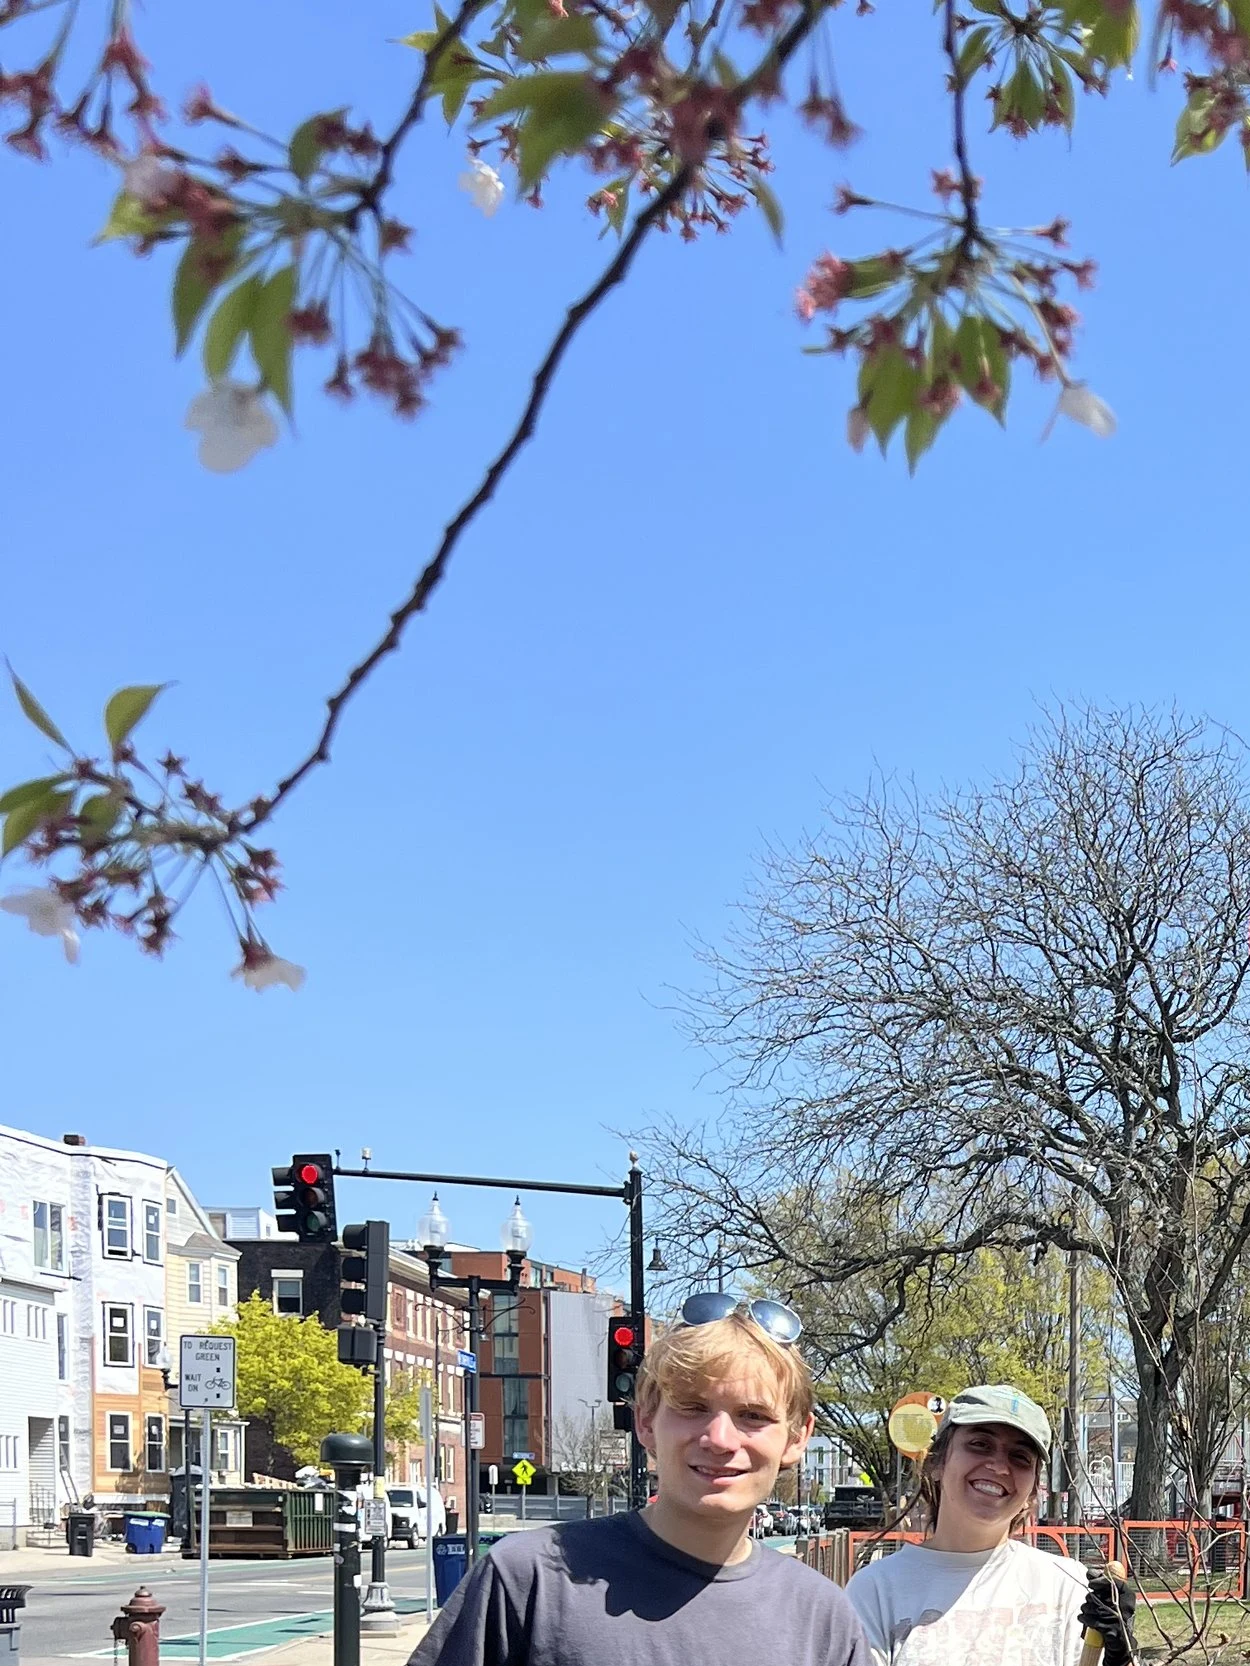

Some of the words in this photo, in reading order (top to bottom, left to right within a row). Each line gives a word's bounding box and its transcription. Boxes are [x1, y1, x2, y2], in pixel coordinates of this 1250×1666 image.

[183, 1341, 193, 1349] TO
[199, 1342, 232, 1350] REQUEST
[195, 1352, 220, 1361] GREEN
[184, 1374, 202, 1382] WAIT
[187, 1384, 199, 1392] ON
